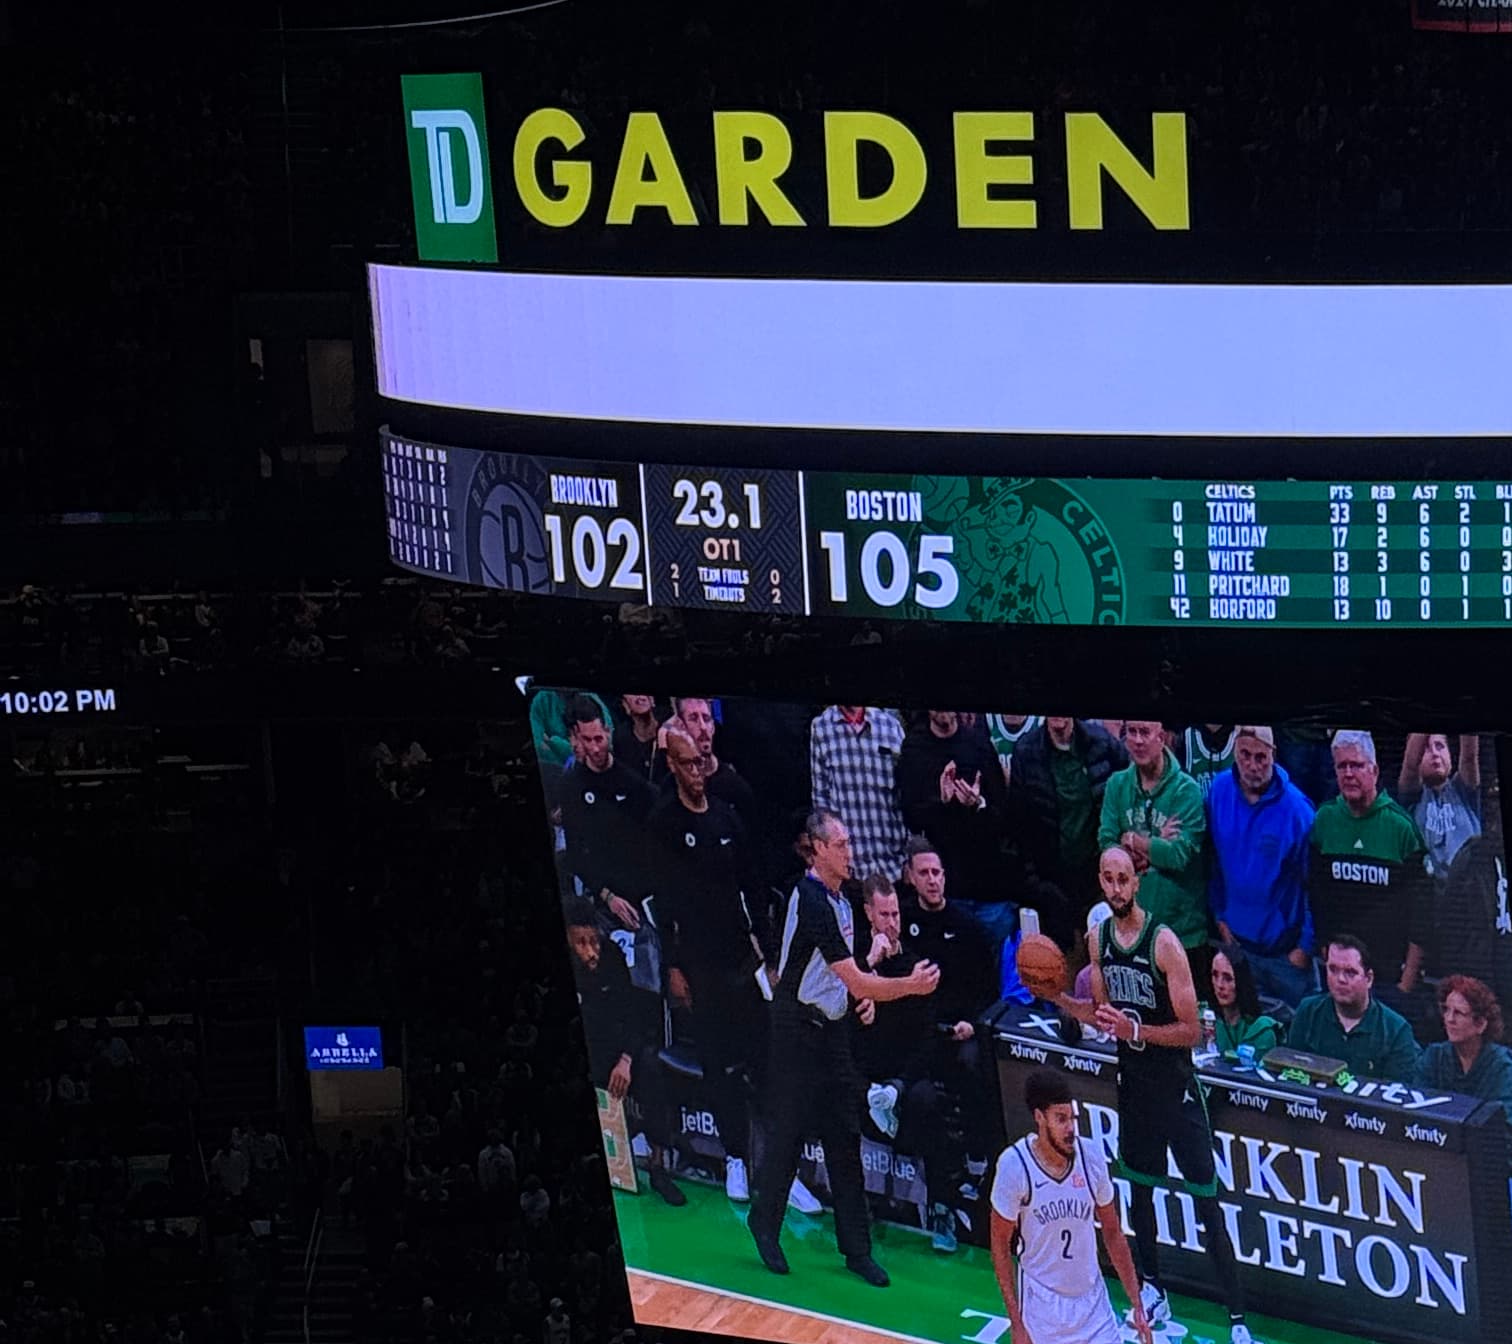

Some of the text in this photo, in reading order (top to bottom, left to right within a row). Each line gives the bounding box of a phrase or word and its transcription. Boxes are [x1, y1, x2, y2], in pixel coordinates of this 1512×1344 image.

[412, 107, 1191, 230] TD GARDEN
[550, 475, 618, 509] BROOKLYN
[673, 478, 761, 529] 23.1
[1205, 484, 1256, 499] CELTICS
[1329, 485, 1353, 500] PTS
[1371, 485, 1396, 500] REB
[1413, 485, 1438, 499] AST
[1454, 485, 1476, 499] STL
[846, 489, 922, 522] BOSTON
[1173, 501, 1350, 524] 0 TATUM 33
[1173, 525, 1348, 548] 4 HOLIDAY 17
[545, 514, 644, 590] 102
[703, 537, 741, 561] OT1
[1174, 549, 1349, 572] 9 WHITE 13
[670, 563, 680, 579] 2
[770, 569, 780, 586] 0
[820, 530, 960, 609] 105
[673, 582, 782, 604] 1 TIMEOUTS 2
[1173, 574, 1349, 597] 11 PRITCHARD 18
[1170, 597, 1391, 620] 42 HORFORD 13 10
[0, 689, 116, 713] 10:02 PM
[1331, 860, 1389, 888] BOSTON
[1010, 1043, 1048, 1065] xfinity
[1063, 1054, 1102, 1076] xfinity
[1228, 1089, 1270, 1113] xfinity
[1285, 1100, 1328, 1124] xfinity
[1343, 1111, 1387, 1136] xfinity
[1404, 1123, 1448, 1148] xfinity
[862, 1152, 916, 1182] etBlue
[1060, 1229, 1073, 1259] 2
